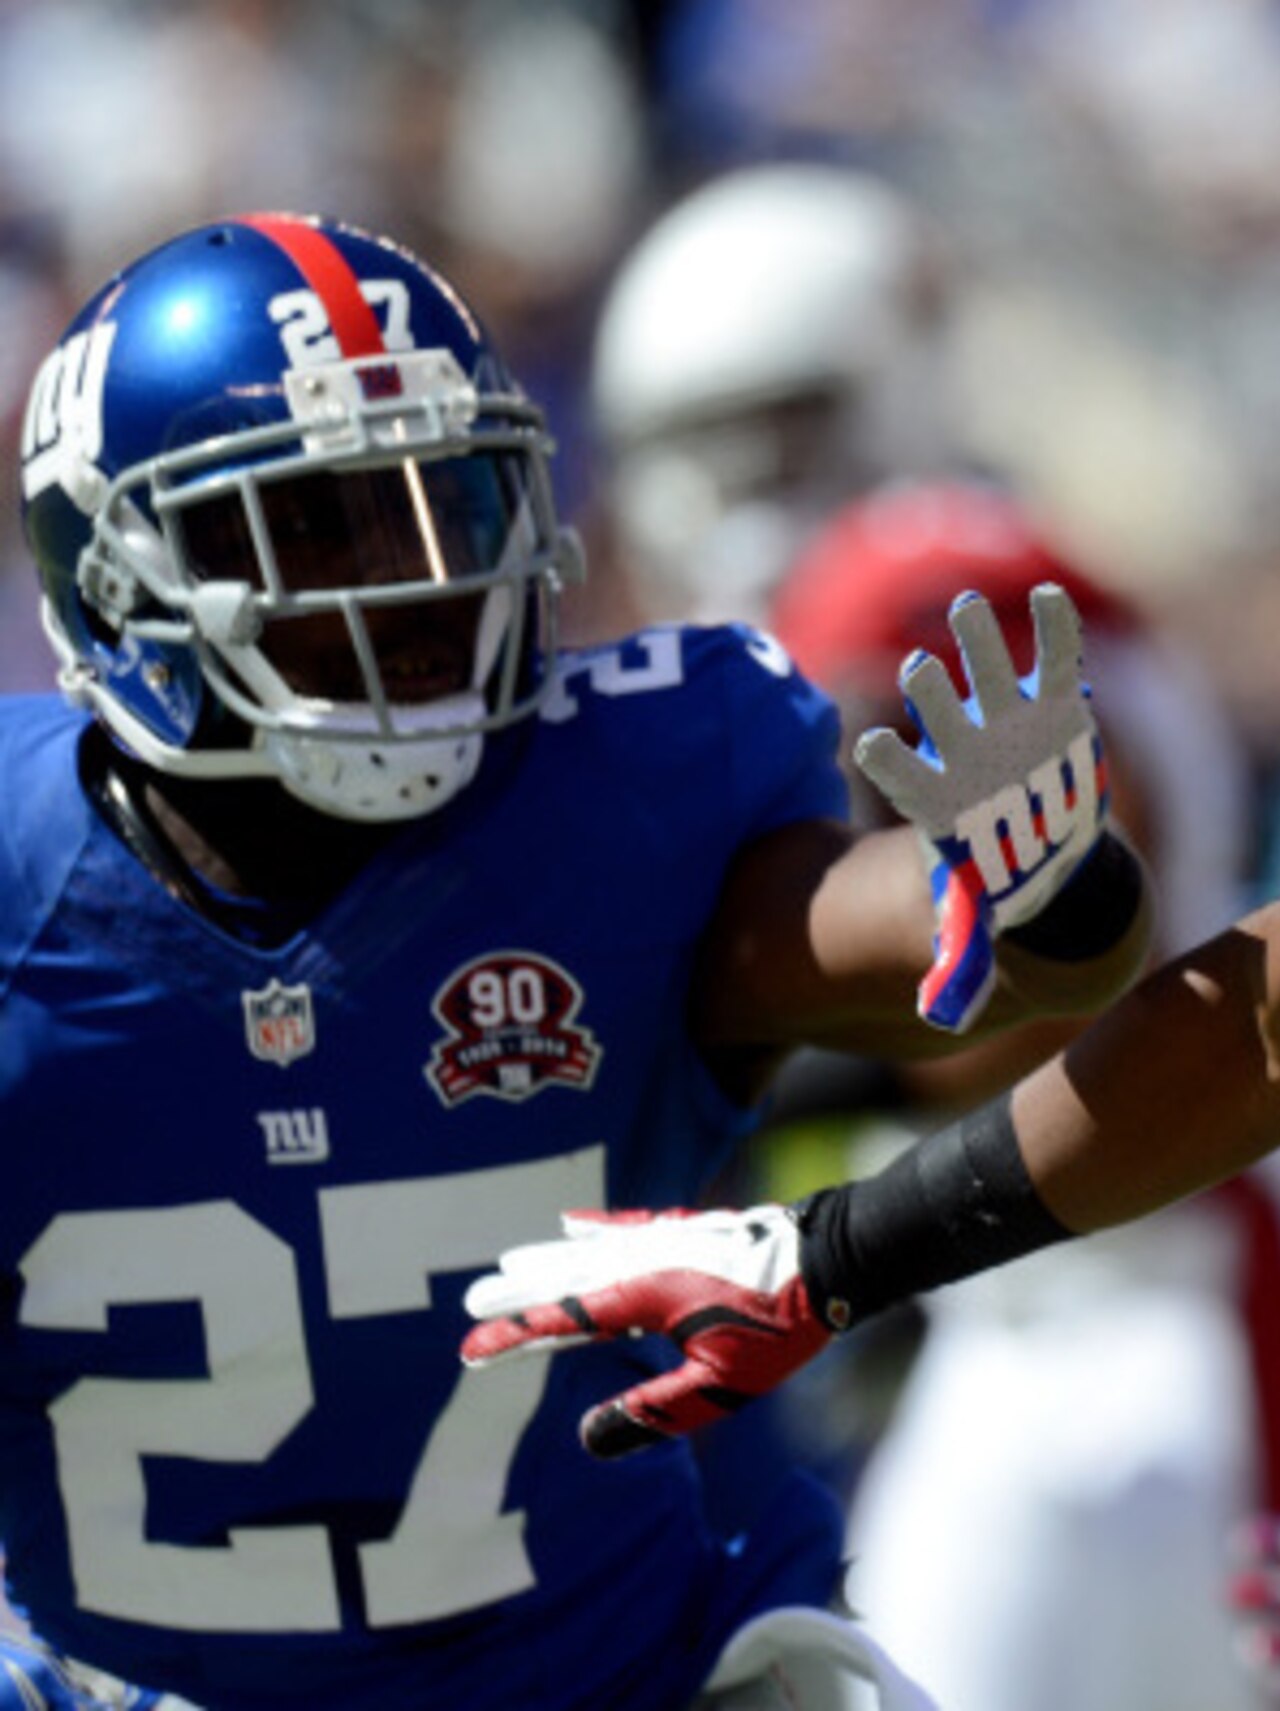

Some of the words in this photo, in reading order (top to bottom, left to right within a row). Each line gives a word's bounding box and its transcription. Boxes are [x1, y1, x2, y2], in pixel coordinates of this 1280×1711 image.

[267, 279, 415, 368] 27
[469, 967, 546, 1028] 90
[256, 1018, 307, 1056] NFL
[17, 1143, 606, 1633] 27
